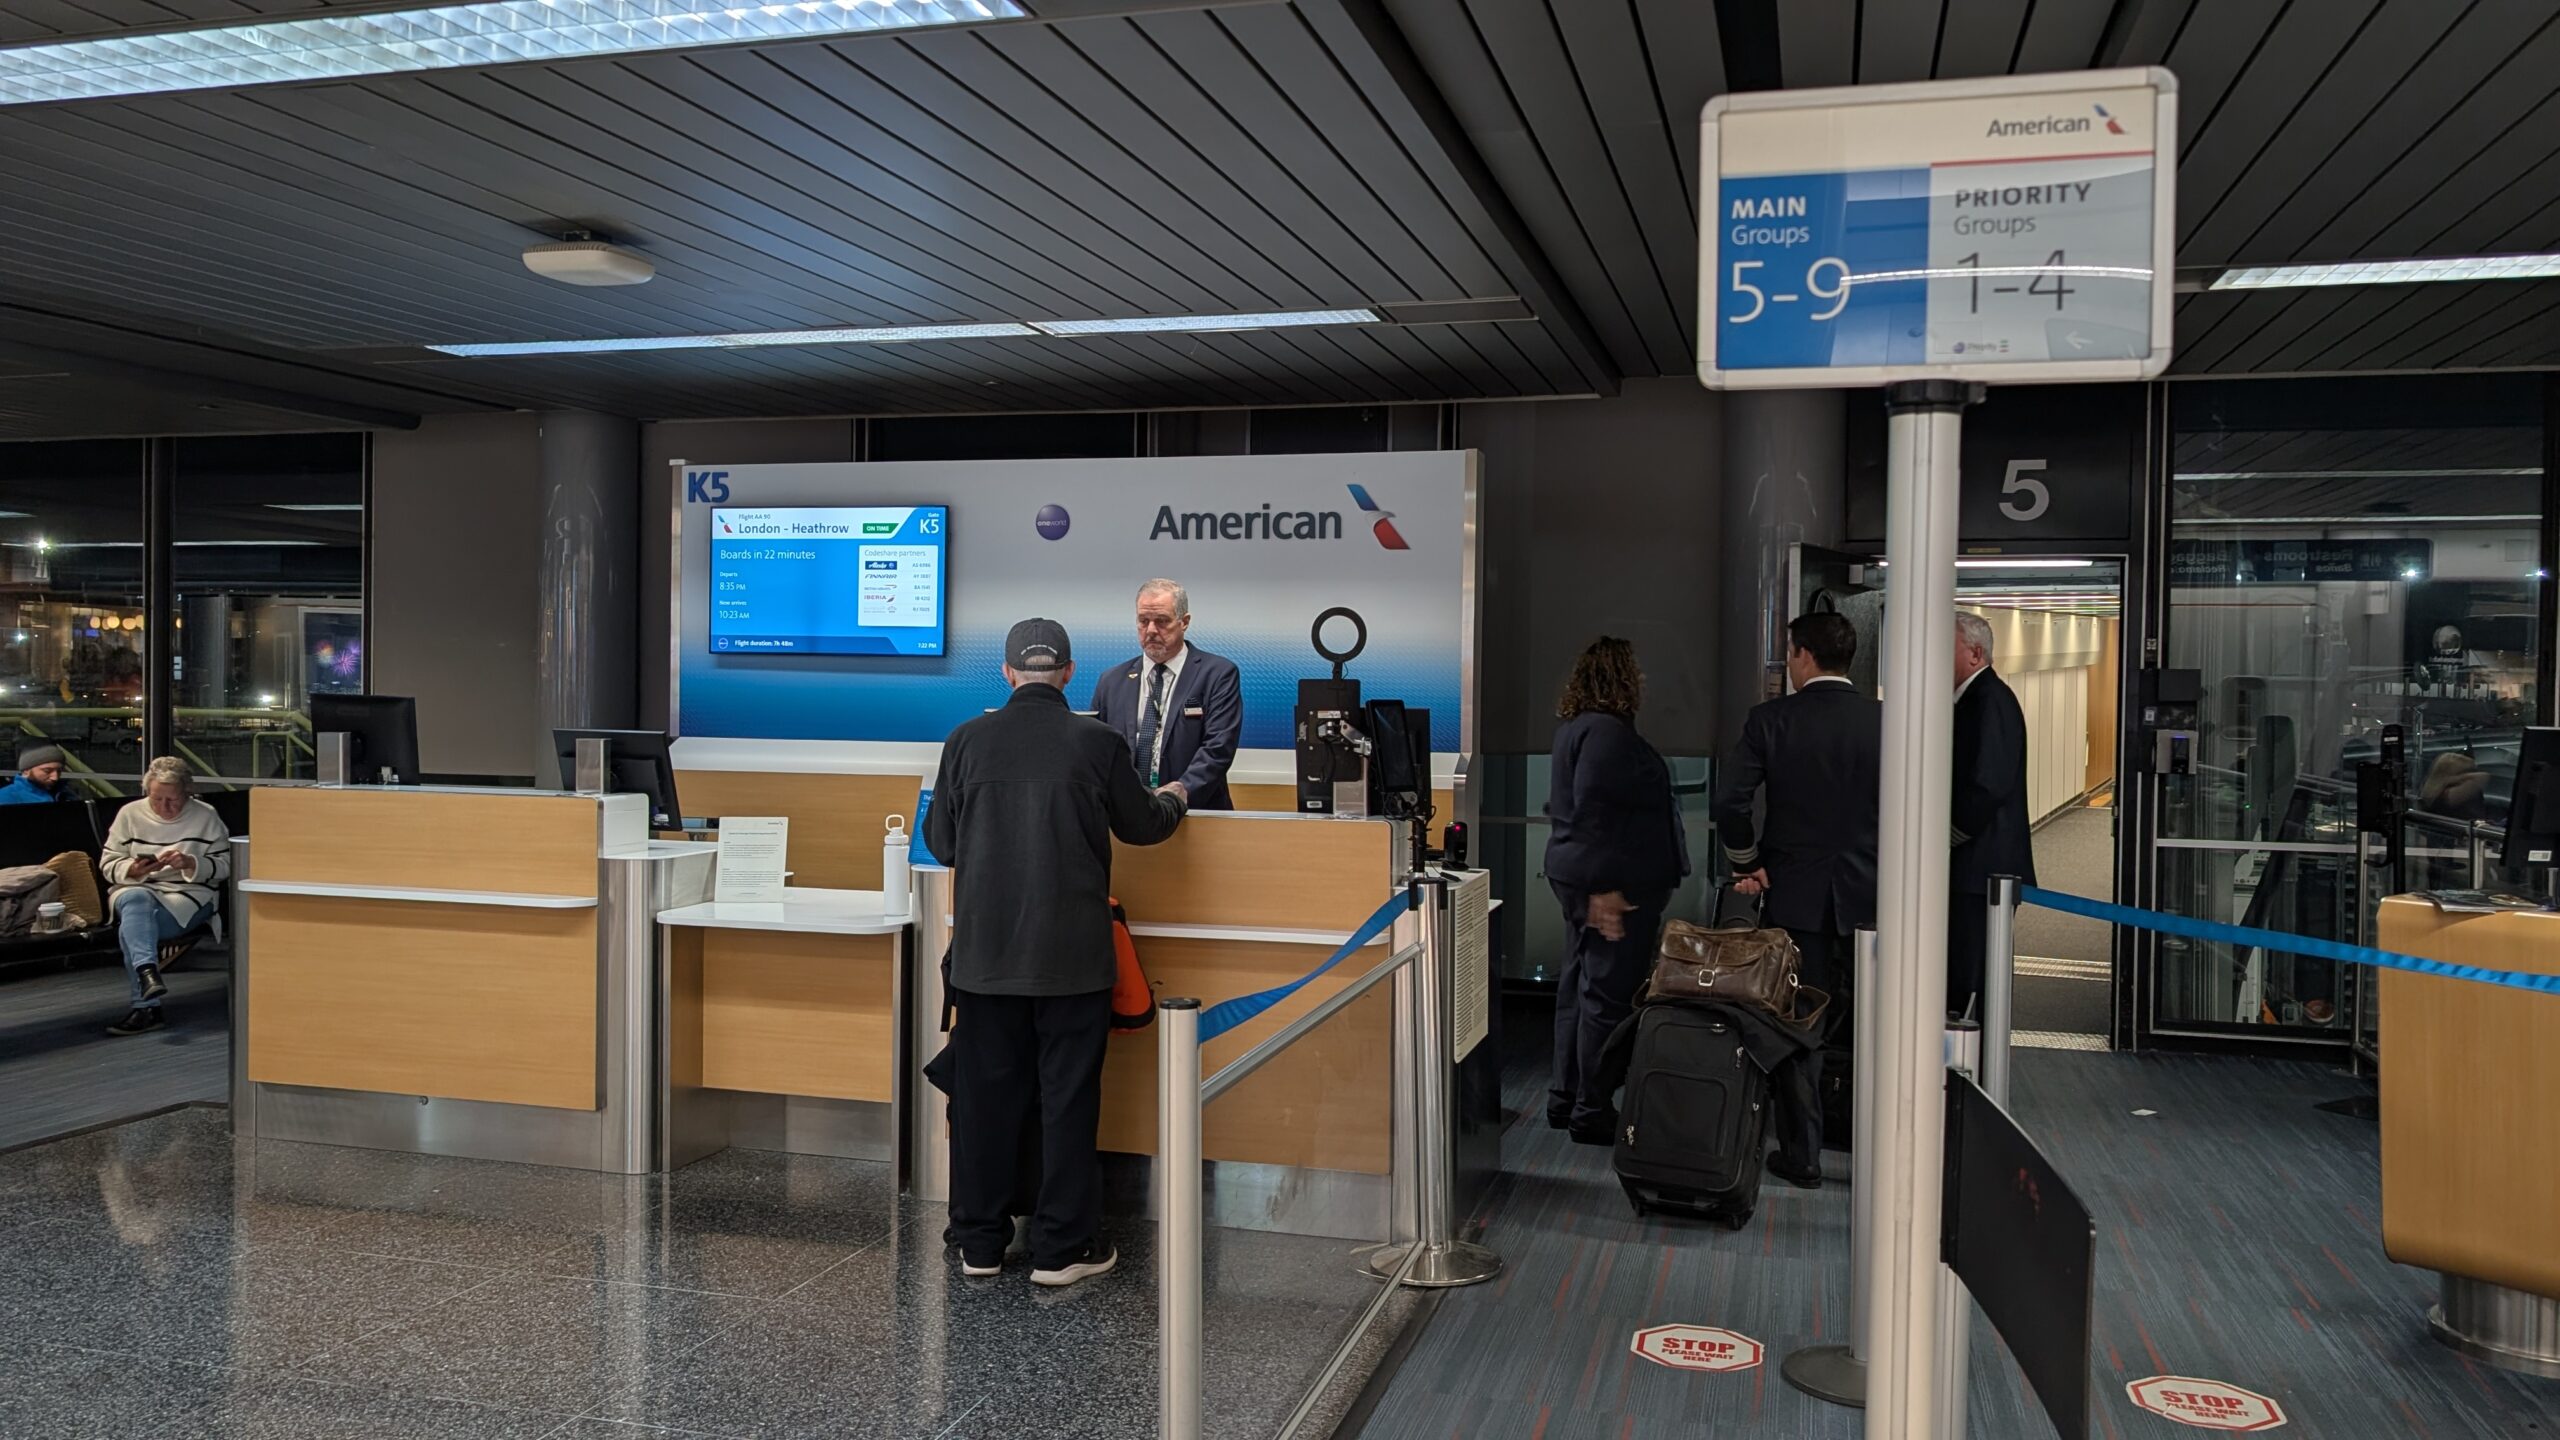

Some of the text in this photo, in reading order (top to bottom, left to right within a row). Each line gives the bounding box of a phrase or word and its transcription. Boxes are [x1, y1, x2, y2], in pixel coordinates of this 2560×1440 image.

[1986, 116, 2091, 138] American
[1955, 183, 2091, 208] PRIORITY
[1731, 196, 1806, 219] MAIN
[1954, 215, 2037, 238] Groups
[1731, 225, 1810, 248] Groups
[688, 472, 729, 503] K5
[1999, 459, 2050, 521] 5
[738, 523, 781, 534] London
[792, 523, 849, 534] Heathrow
[919, 519, 940, 534] K5
[1149, 503, 1342, 540] American
[720, 549, 816, 560] Boards in 22 minutes
[864, 549, 926, 558] Codeshare partners
[720, 582, 735, 591] 8:35
[719, 610, 738, 619] 10:23
[1662, 1337, 1735, 1353] STOP
[1661, 1348, 1735, 1360] PLEASE WAIT
[1683, 1355, 1712, 1363] HERE
[2160, 1390, 2245, 1409] STOP
[2166, 1402, 2250, 1417] PLEASE WAIT
[2195, 1411, 2228, 1420] HERE
